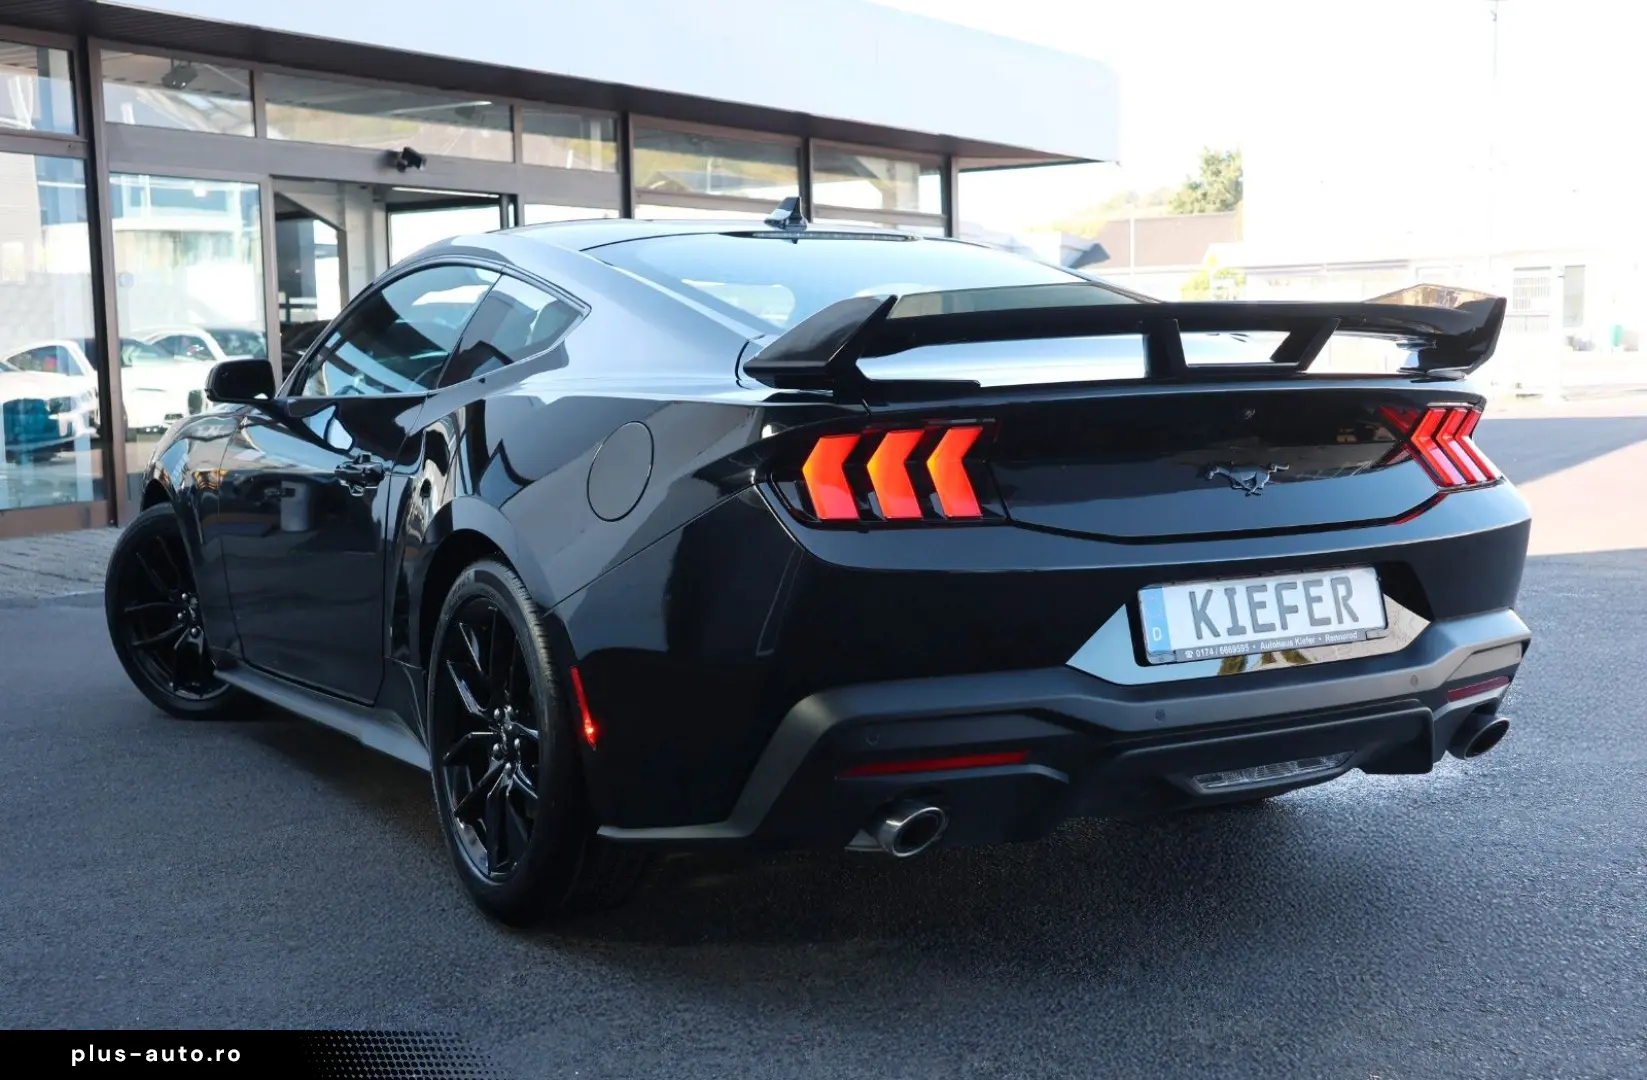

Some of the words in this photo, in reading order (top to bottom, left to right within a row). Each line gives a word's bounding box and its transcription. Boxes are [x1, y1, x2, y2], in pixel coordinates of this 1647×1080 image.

[1189, 576, 1359, 639] KIEFER
[1153, 628, 1161, 641] D
[1195, 646, 1215, 658] 0174
[1260, 639, 1294, 650] Autohaus
[1295, 636, 1316, 647] Kiefer
